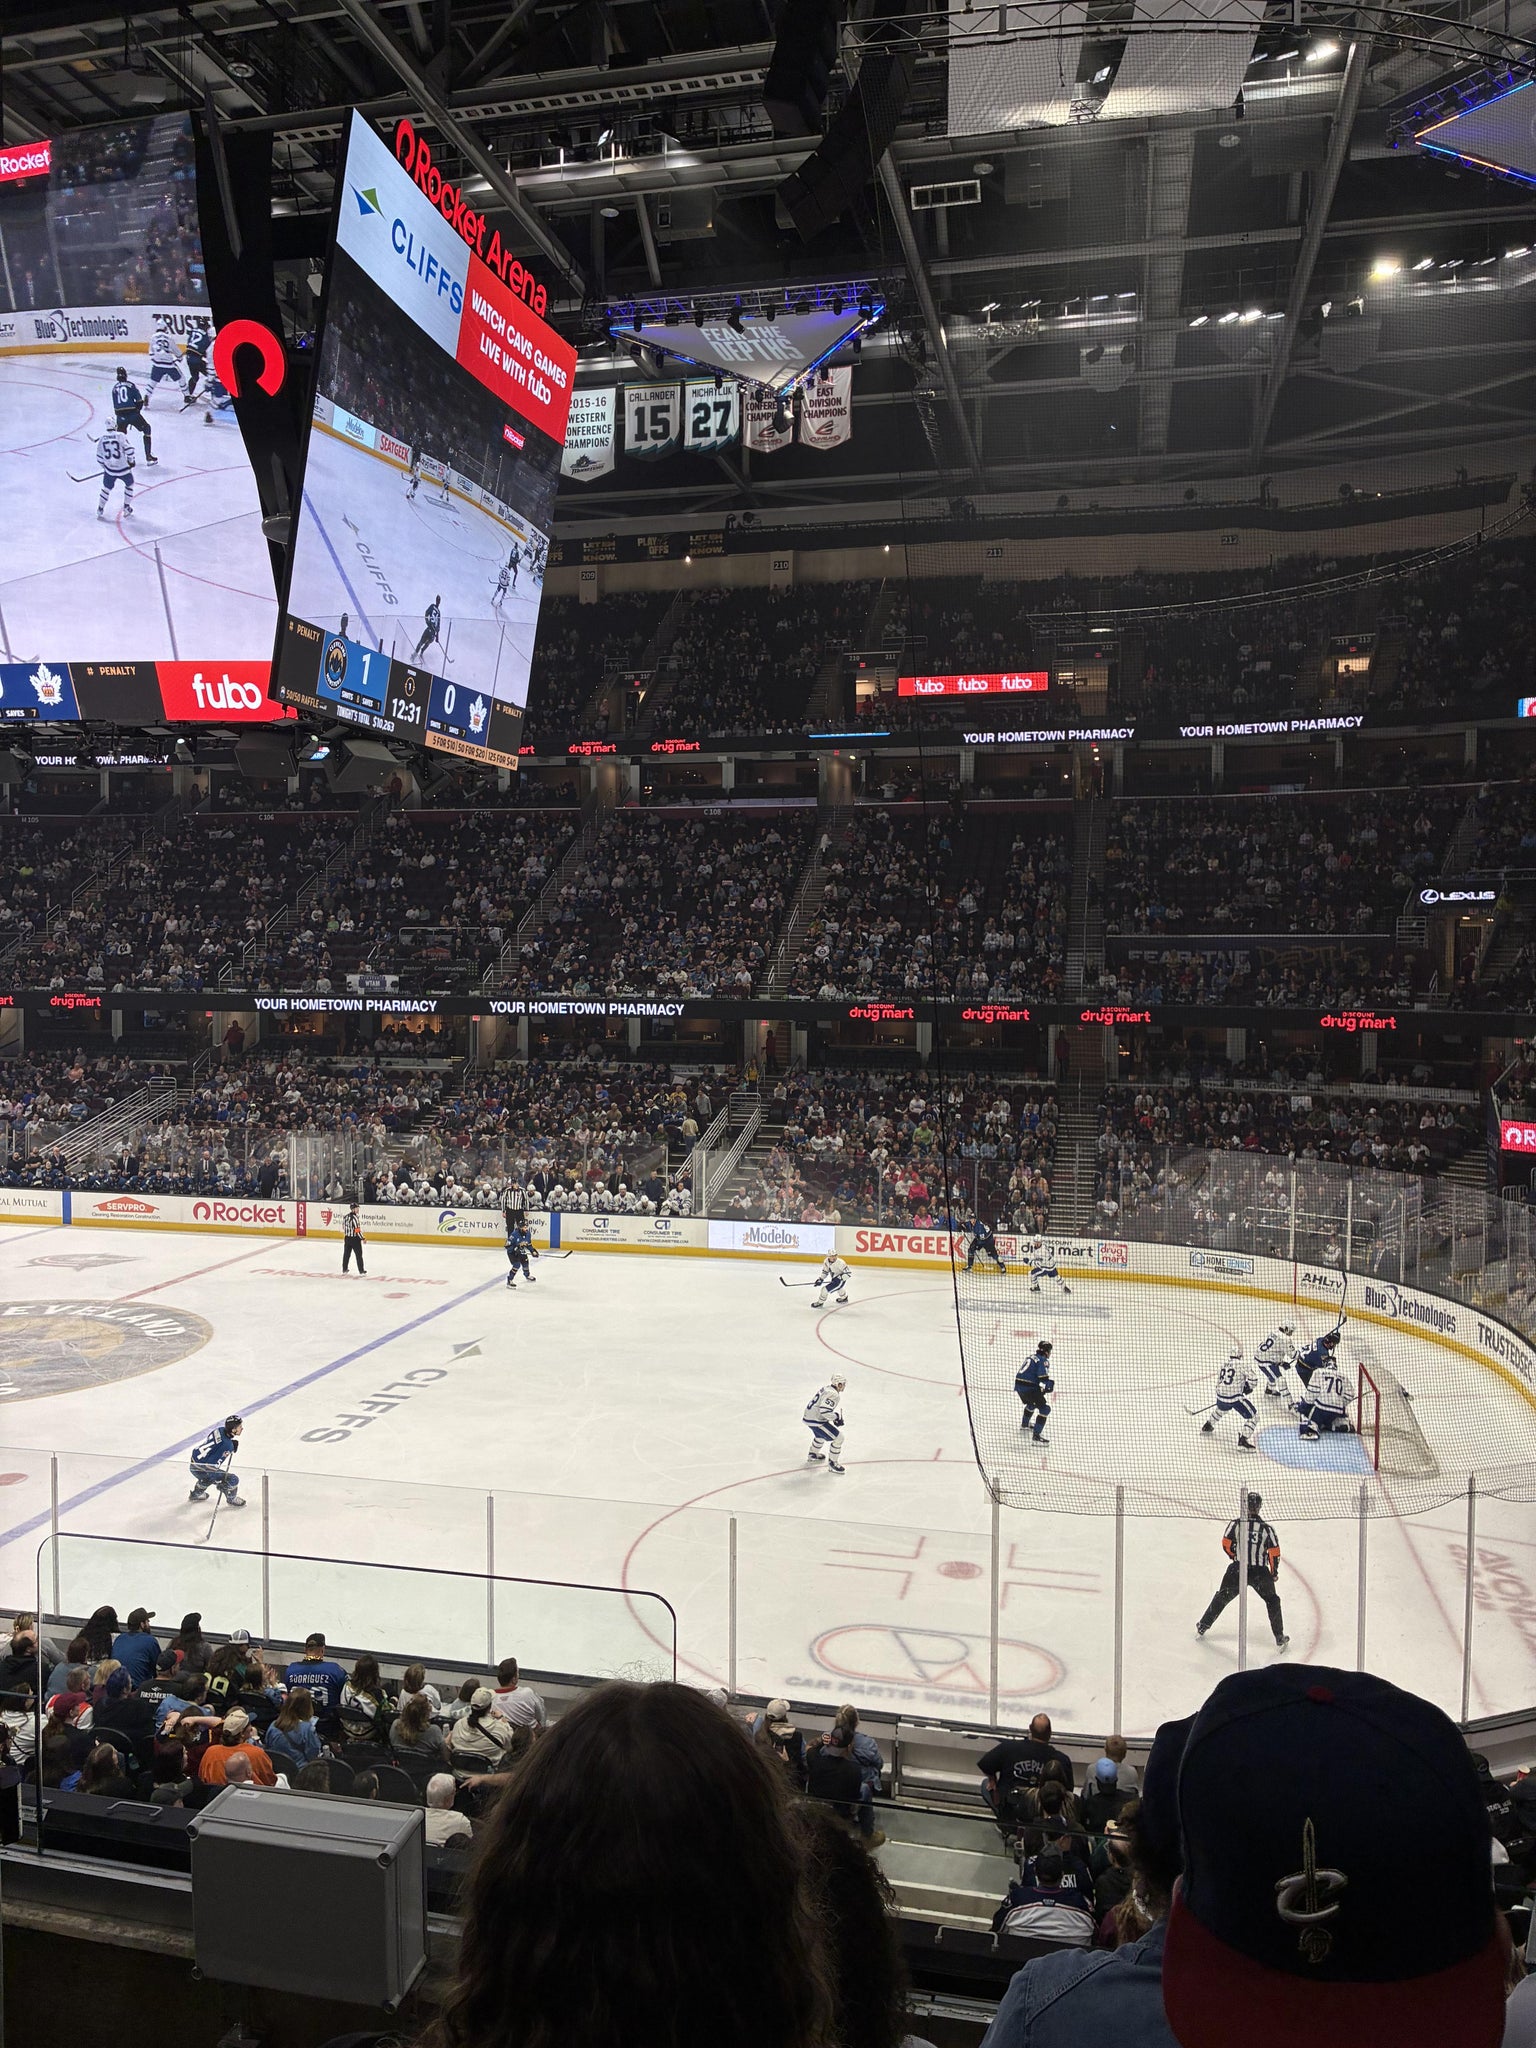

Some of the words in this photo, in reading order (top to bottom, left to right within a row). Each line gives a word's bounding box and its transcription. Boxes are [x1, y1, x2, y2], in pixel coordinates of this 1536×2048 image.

[0, 150, 50, 174] Rocket
[415, 138, 487, 257] Rocket
[486, 230, 548, 318] Arena
[391, 218, 462, 315] CLIFFS
[35, 318, 56, 339] Blue
[65, 315, 129, 340] Technologies
[700, 328, 748, 341] FEAR
[747, 326, 787, 339] THE
[472, 289, 506, 337] WATCH
[507, 325, 533, 360] CAVS
[535, 349, 567, 389] GAMES
[709, 338, 805, 362] DEPTHS
[480, 332, 500, 367] LIVE
[502, 351, 526, 384] WITH
[528, 369, 552, 405] fubo
[116, 387, 129, 404] 10
[630, 390, 675, 402] CALLANDER
[692, 386, 733, 398] MICHAYLUK
[816, 387, 833, 397] EAST
[809, 397, 842, 408] DIVISION
[568, 411, 606, 424] WESTERN
[692, 400, 731, 438] 27
[804, 406, 847, 419] CHAMPIONS
[566, 424, 612, 437] ONFERENCE
[634, 405, 670, 442] 15
[103, 440, 121, 460] 53
[380, 434, 411, 464] SEATGEEK
[564, 437, 610, 449] CHAMPIONS
[773, 561, 788, 570] 210
[356, 542, 398, 605] CLIFFS
[581, 572, 595, 580] 209
[297, 625, 321, 642] PENALTY
[100, 666, 136, 676] PENALTY
[362, 653, 371, 686] 1
[192, 673, 262, 710] fubo
[915, 679, 944, 693] fubo
[957, 678, 988, 691] fubo
[1001, 676, 1032, 689] fubo
[286, 690, 301, 703] 50/50
[301, 694, 320, 709] RAFFLE
[444, 684, 456, 715] 0
[6, 709, 25, 717] SAVES
[392, 697, 421, 725] 12:31
[502, 705, 523, 719] PENALTY
[1180, 725, 1213, 737] YOUR
[1216, 721, 1288, 736] HOMETOWN
[1291, 716, 1363, 731] PHARMACY
[963, 731, 994, 743] YOUR
[997, 729, 1065, 742] HOMETOWN
[1069, 728, 1135, 741] PHARMACY
[433, 736, 437, 745] 5
[437, 737, 447, 748] FOR
[458, 741, 465, 752] 50
[465, 743, 475, 755] FOR
[488, 751, 496, 762] 125
[497, 753, 507, 765] FOR
[569, 744, 591, 755] drug
[593, 744, 617, 753] mart
[651, 742, 675, 754] drug
[676, 741, 700, 751] mart
[35, 756, 62, 765] YOUR
[1440, 891, 1495, 900] LEXUS
[50, 996, 74, 1009] drug
[75, 996, 101, 1007] mart
[254, 999, 289, 1011] YOUR
[291, 999, 363, 1012] HOMETOWN
[366, 1000, 437, 1012] PHARMACY
[489, 1001, 525, 1014] YOUR
[529, 1002, 606, 1015] HOMETOWN
[609, 1003, 684, 1016] PHARMACY
[849, 1007, 880, 1021] drug
[882, 1007, 914, 1019] mart
[962, 1009, 994, 1023] drug
[996, 1008, 1029, 1020] mart
[1080, 1010, 1113, 1025] drug
[1116, 1010, 1151, 1023] mart
[1320, 1014, 1356, 1031] drug
[1359, 1016, 1396, 1030] mart
[13, 1198, 48, 1207] MUTUAL
[106, 1203, 146, 1211] SERVPRO
[213, 1202, 286, 1223] Rocket
[458, 1220, 499, 1229] CENTURY
[749, 1227, 792, 1244] Modelo
[1058, 1245, 1094, 1257] mart
[1100, 1245, 1123, 1257] drug
[1102, 1255, 1127, 1264] mart
[1206, 1255, 1226, 1266] HOME
[1365, 1286, 1387, 1310] Blue
[1398, 1296, 1457, 1333] Technologies
[1478, 1321, 1532, 1383] TRUSTEDSEC
[1325, 1376, 1343, 1396] 70
[301, 1368, 447, 1443] CLIFFS
[825, 1398, 836, 1407] 53
[785, 1675, 832, 1690] CAR
[838, 1681, 916, 1700] PARTS
